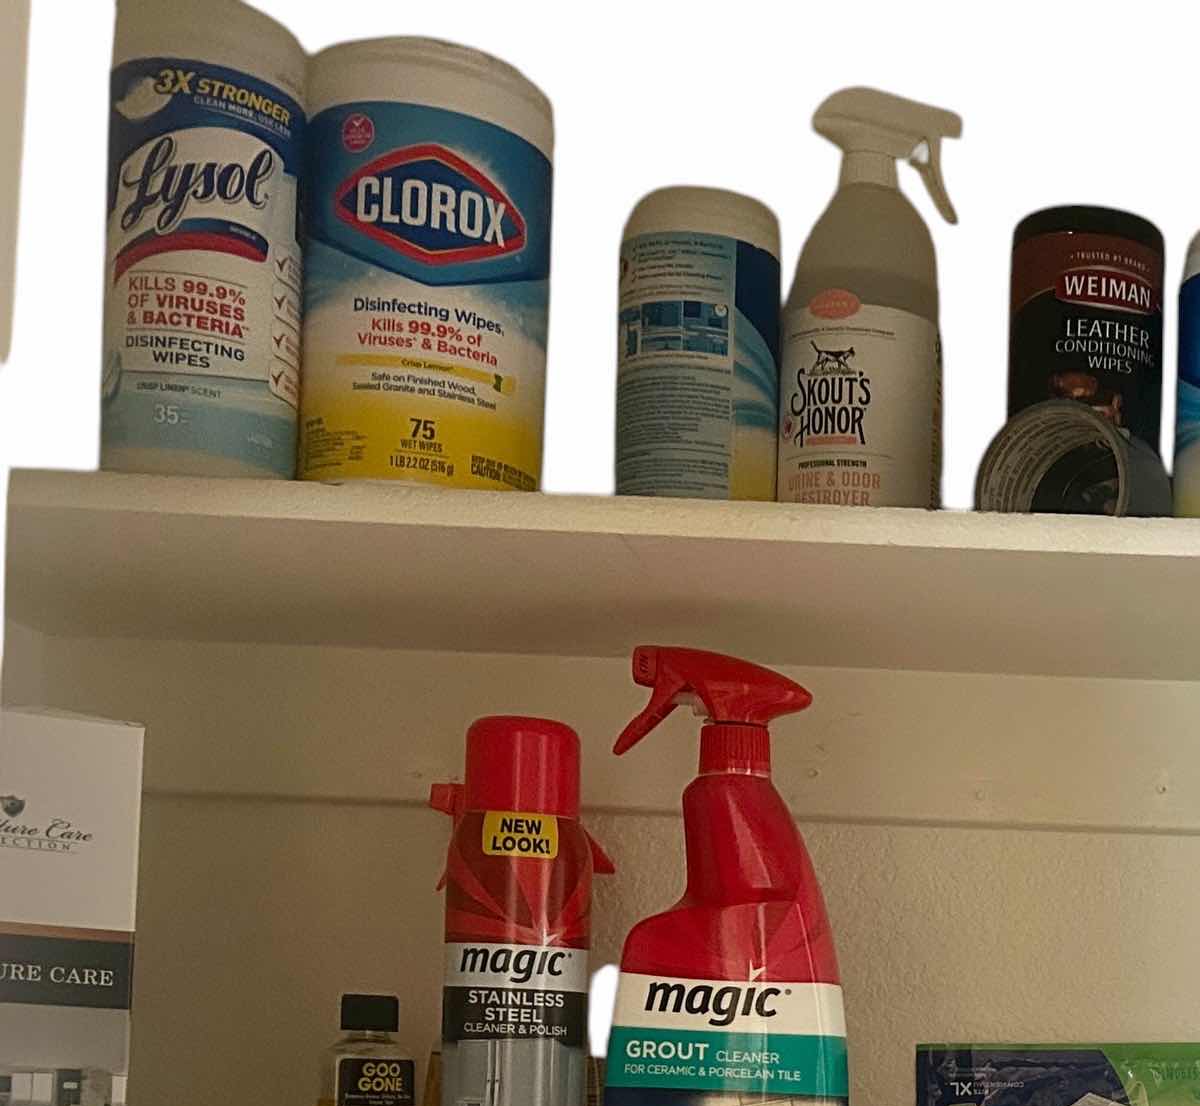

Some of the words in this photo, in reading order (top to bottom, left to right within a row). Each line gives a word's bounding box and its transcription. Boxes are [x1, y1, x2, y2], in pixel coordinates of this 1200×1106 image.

[154, 68, 194, 95] 3X
[197, 78, 290, 126] STRONGER
[121, 136, 273, 232] Lysol
[356, 176, 506, 249] CLOROX
[128, 276, 176, 292] KILLS
[182, 279, 246, 306] 99.9%
[1065, 275, 1151, 309] WEIMAN
[127, 310, 138, 326] &
[128, 293, 150, 307] OF
[156, 294, 246, 322] VIRUSES
[353, 297, 450, 321] Disinfecting
[372, 318, 404, 332] Kills
[408, 320, 463, 342] 99.9%
[467, 333, 483, 347] of
[1066, 319, 1150, 349] LEATHER
[126, 335, 245, 362] DISINFECTING
[152, 350, 210, 369] WIPES
[421, 337, 432, 350] &
[437, 340, 498, 366] Bacteria
[1055, 338, 1154, 367] CONDITIONING
[1088, 355, 1132, 374] WIPES
[191, 385, 222, 399] SCENT
[791, 367, 872, 416] SKOUT'S
[153, 404, 179, 425] 35
[409, 418, 436, 441] 75
[793, 406, 868, 448] HONOR
[400, 439, 418, 450] WET
[418, 440, 443, 453] WIPES
[826, 473, 836, 487] &
[842, 472, 881, 489] ODOR
[46, 816, 94, 843] Care
[501, 818, 542, 835] NEW
[492, 836, 550, 854] LOOK!
[50, 966, 114, 987] CARE
[460, 947, 565, 983] magic
[468, 990, 564, 1008] STAINLESS
[645, 981, 781, 1027] magic
[485, 1008, 543, 1023] STEEL
[464, 1022, 515, 1034] CLEANER
[518, 1024, 527, 1034] &
[529, 1024, 567, 1036] POLISH
[626, 1040, 710, 1061] GROUT
[716, 1051, 780, 1065] CLEANER
[362, 1063, 400, 1077] GOO
[624, 1064, 645, 1076] FOR
[647, 1065, 696, 1077] CERAMIC
[698, 1067, 706, 1077] &
[708, 1067, 775, 1080] PORCELAIN
[777, 1069, 801, 1081] TILE
[358, 1077, 402, 1092] GONE
[950, 1082, 972, 1097] XL
